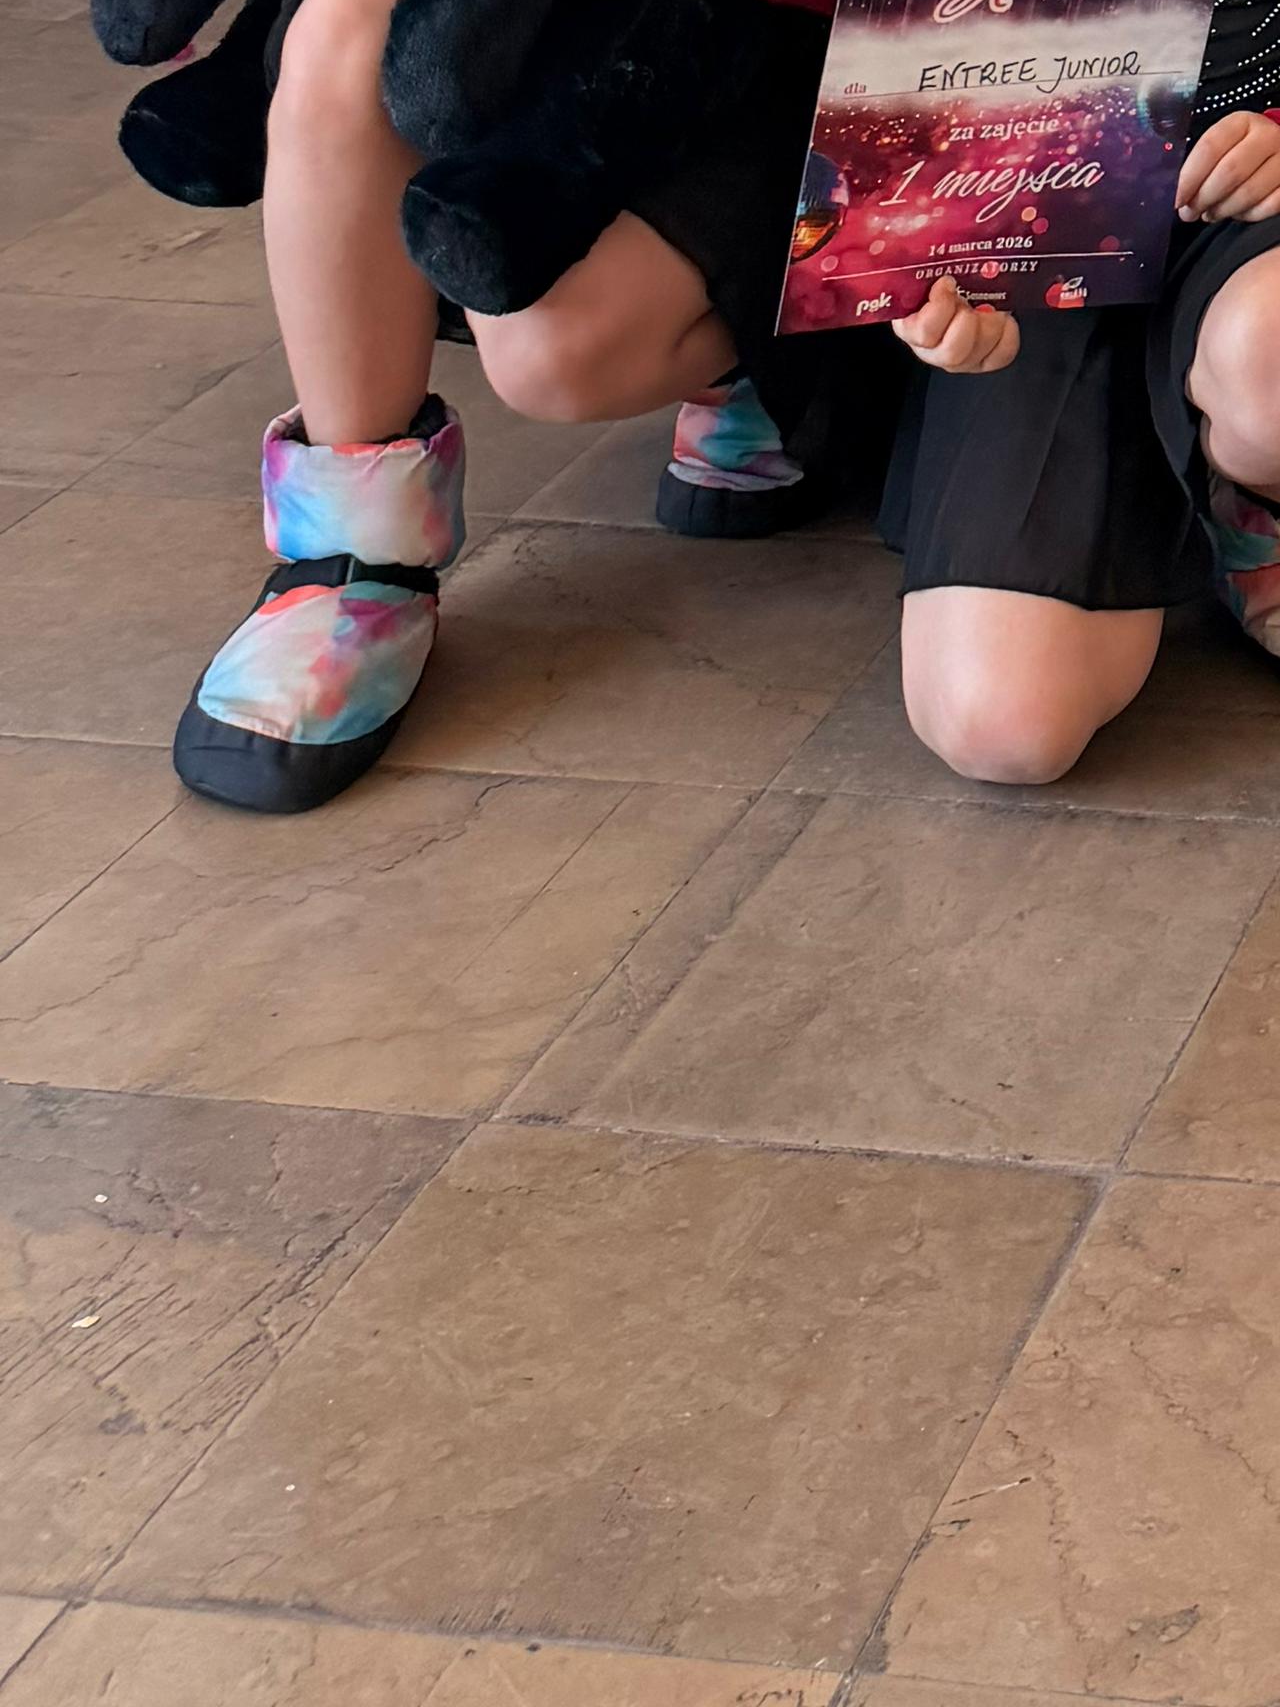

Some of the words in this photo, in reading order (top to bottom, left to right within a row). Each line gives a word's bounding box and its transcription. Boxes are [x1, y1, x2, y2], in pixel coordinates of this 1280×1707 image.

[917, 57, 1038, 92] ENTREE
[1035, 50, 1143, 94] JUNIOR
[844, 82, 867, 95] dla
[949, 124, 975, 142] za
[980, 117, 1061, 141] zajęcie
[931, 155, 1105, 224] miejsca
[928, 244, 946, 257] 14
[948, 239, 993, 253] marca
[995, 235, 1034, 250] 2026
[915, 260, 1039, 281] ORGANIZATORZY
